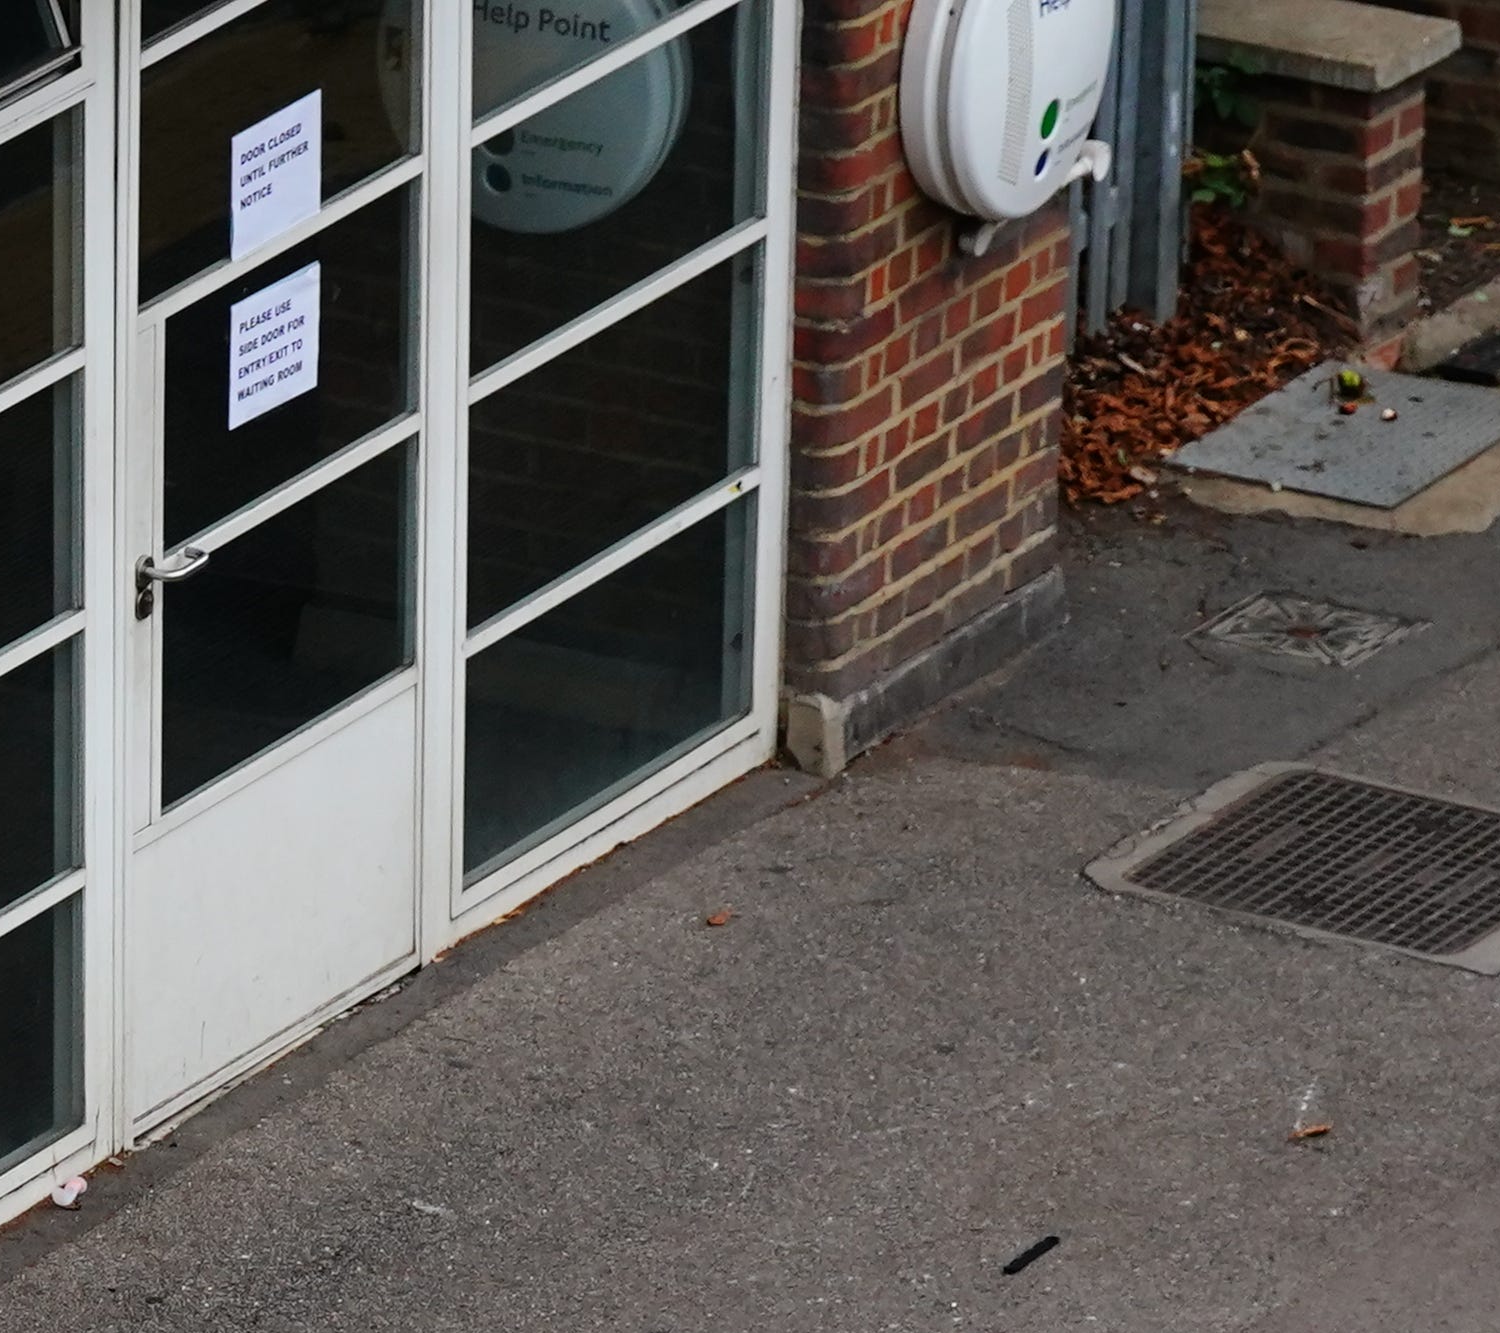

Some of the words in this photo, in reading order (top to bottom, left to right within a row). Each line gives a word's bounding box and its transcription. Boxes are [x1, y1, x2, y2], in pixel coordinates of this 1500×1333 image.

[538, 9, 612, 42] Point
[240, 143, 266, 166] DOOR
[267, 122, 302, 150] CLOSED
[240, 165, 266, 188] UNTIL
[268, 140, 309, 172] FURTHER
[240, 182, 273, 211] NOTICE
[239, 308, 272, 335] PLEASE
[274, 298, 292, 317] USE
[239, 339, 259, 357] SIDE
[260, 326, 286, 346] DOOR
[287, 315, 305, 333] FOR
[291, 338, 304, 353] TO
[237, 374, 275, 401] WAITING
[277, 359, 303, 382] ROOM
